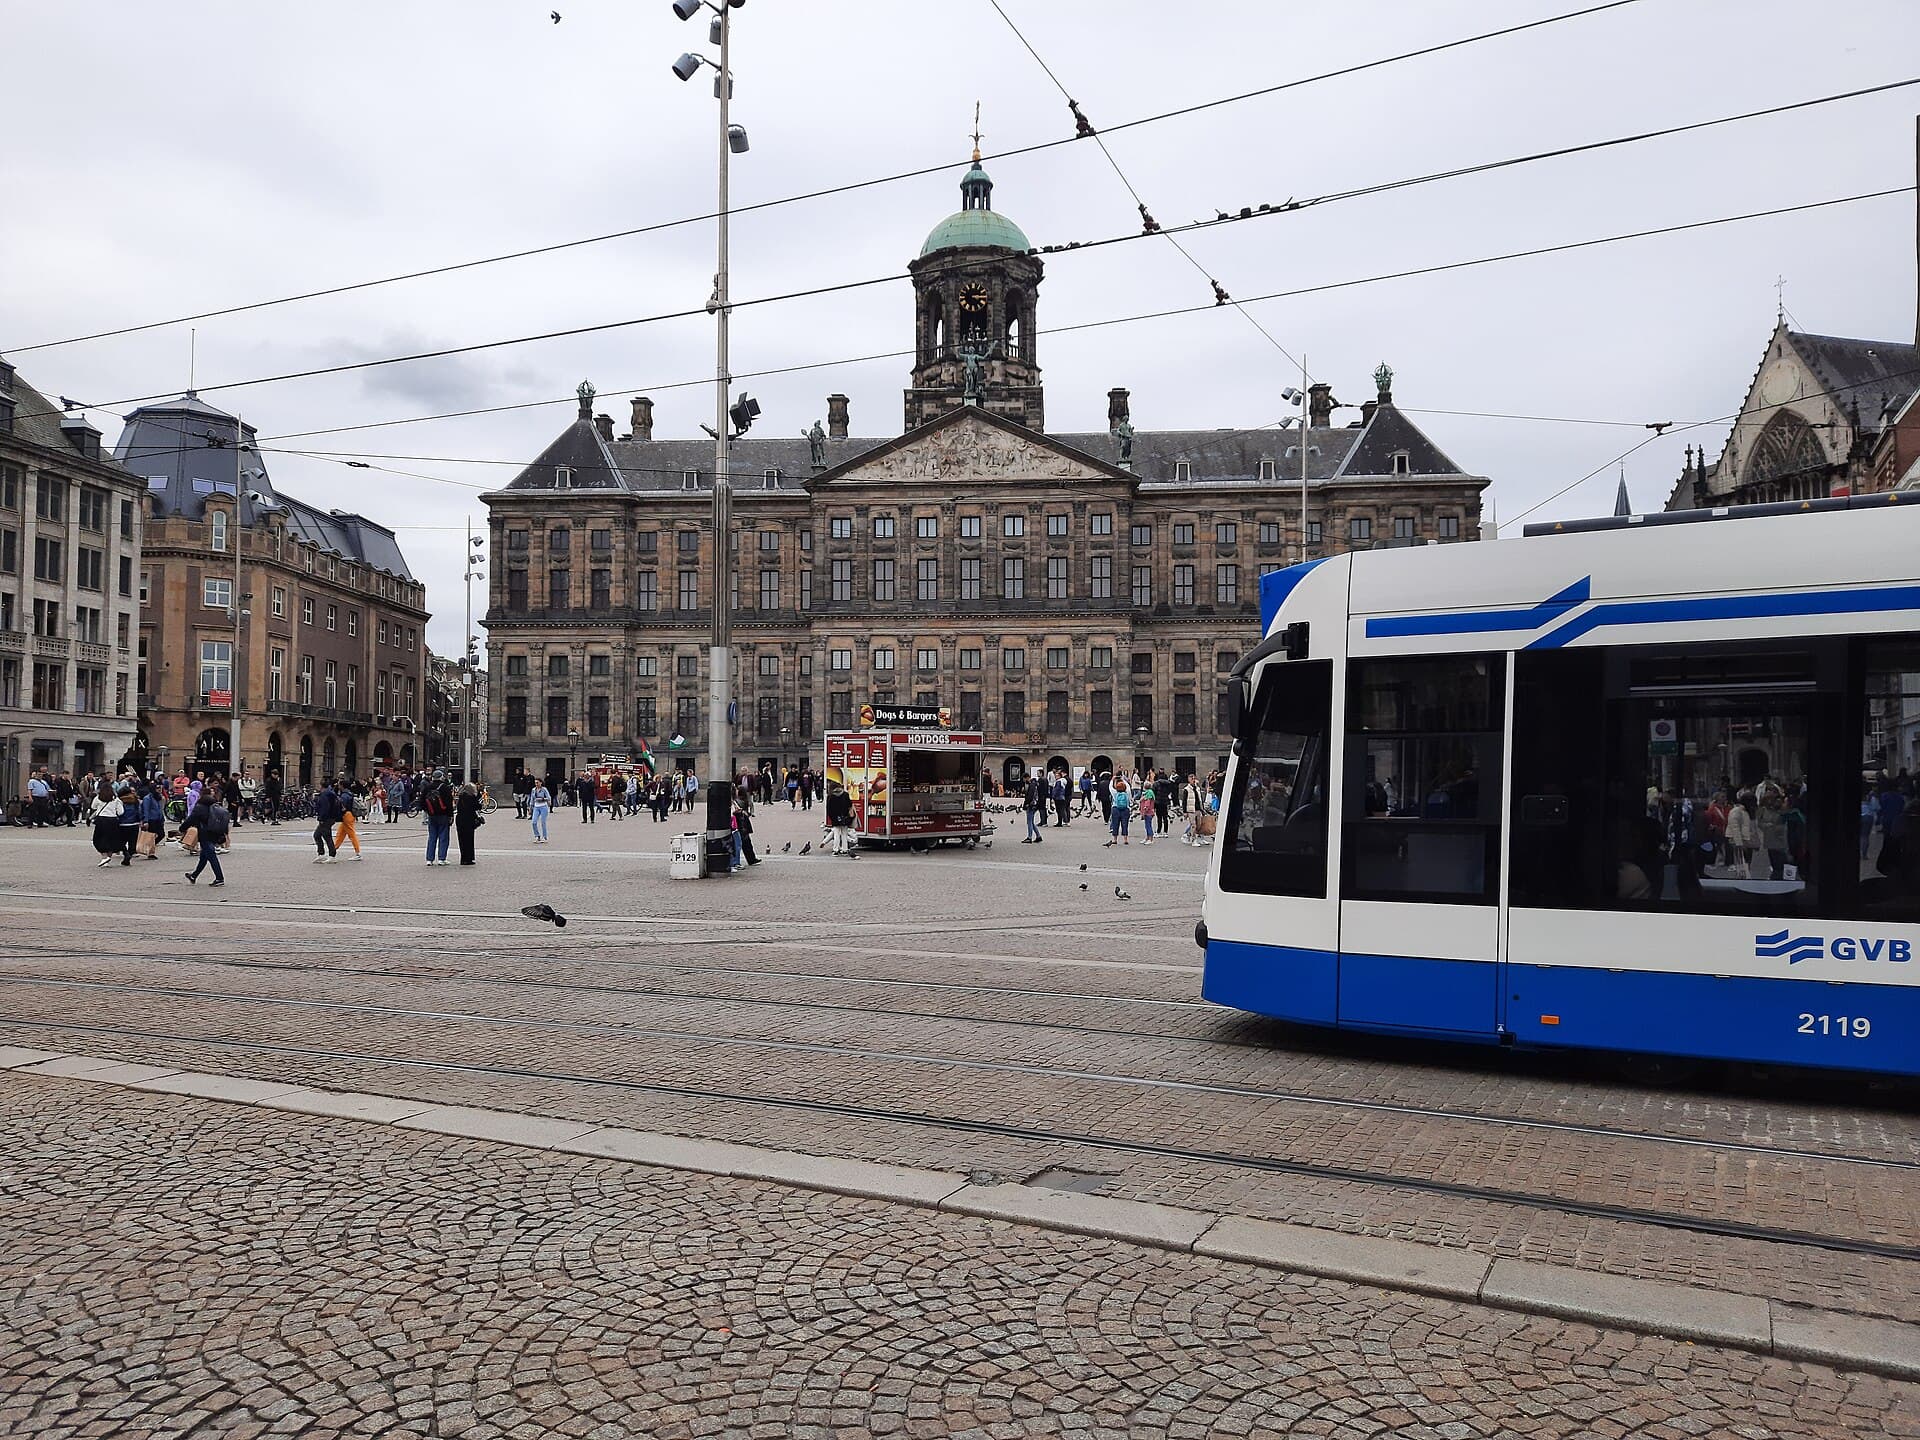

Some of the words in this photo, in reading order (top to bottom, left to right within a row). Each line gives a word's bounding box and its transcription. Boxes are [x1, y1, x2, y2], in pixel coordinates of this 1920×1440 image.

[876, 709, 897, 721] Dogs
[899, 710, 905, 719] &
[906, 711, 938, 722] Burgers
[908, 734, 950, 744] HOTDOGS
[675, 853, 697, 862] P129
[1830, 937, 1912, 962] GVB
[1797, 1013, 1871, 1038] 2119
